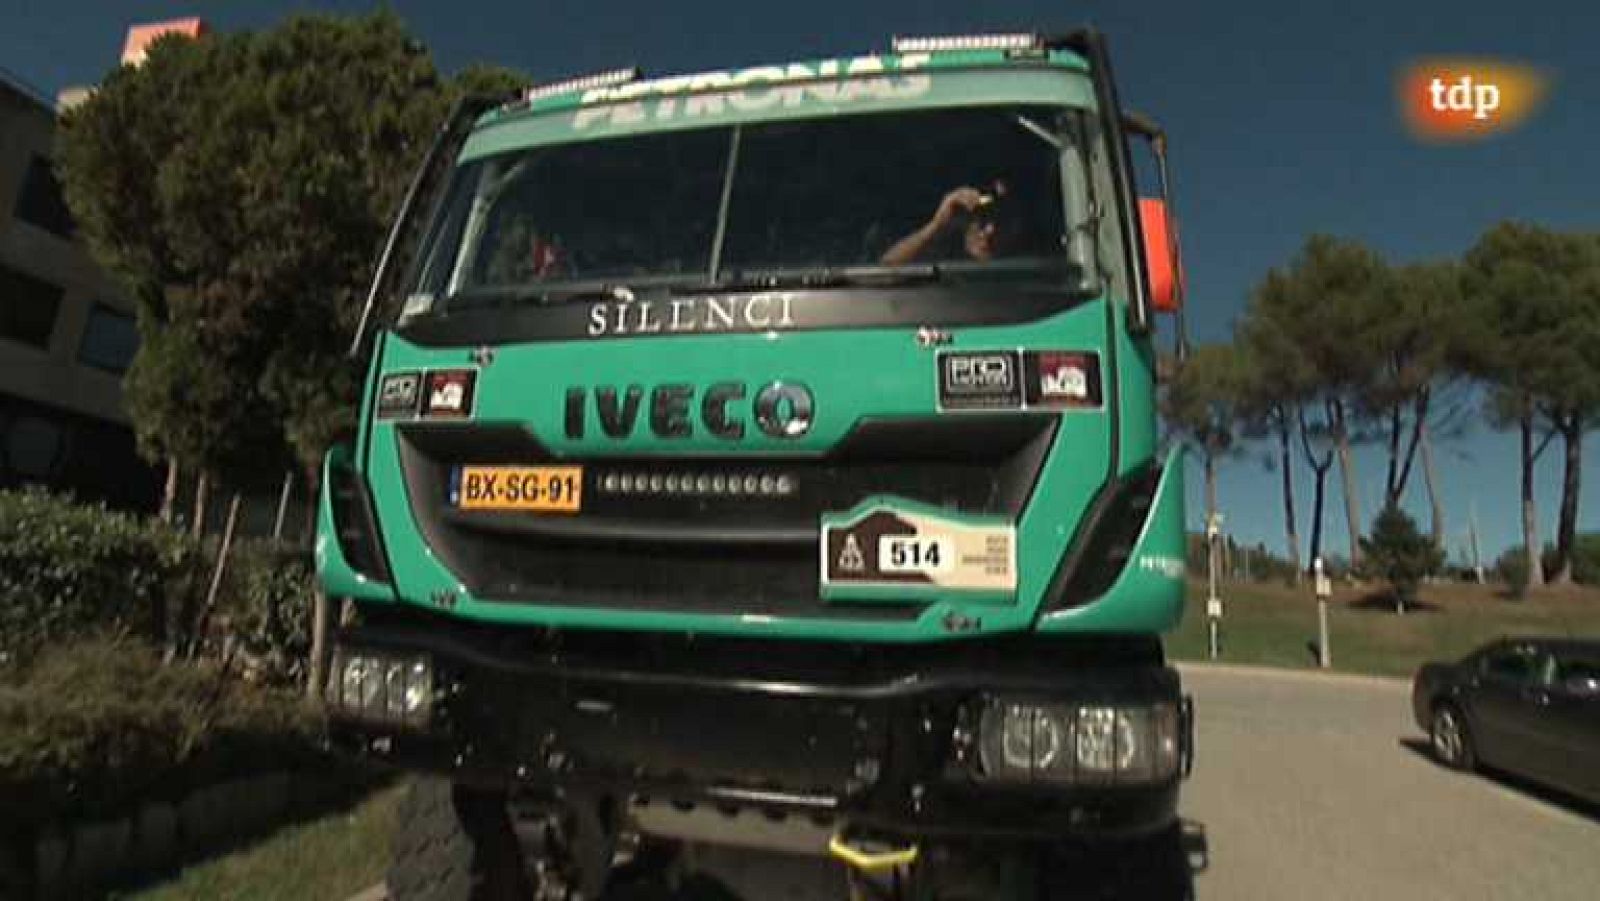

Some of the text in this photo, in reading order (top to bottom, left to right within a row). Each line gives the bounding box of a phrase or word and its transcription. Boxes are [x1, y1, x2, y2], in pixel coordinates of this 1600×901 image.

[588, 293, 795, 335] SILENCI
[563, 379, 815, 441] IVECO
[466, 472, 575, 503] BX-SG-91
[891, 541, 940, 567] 514
